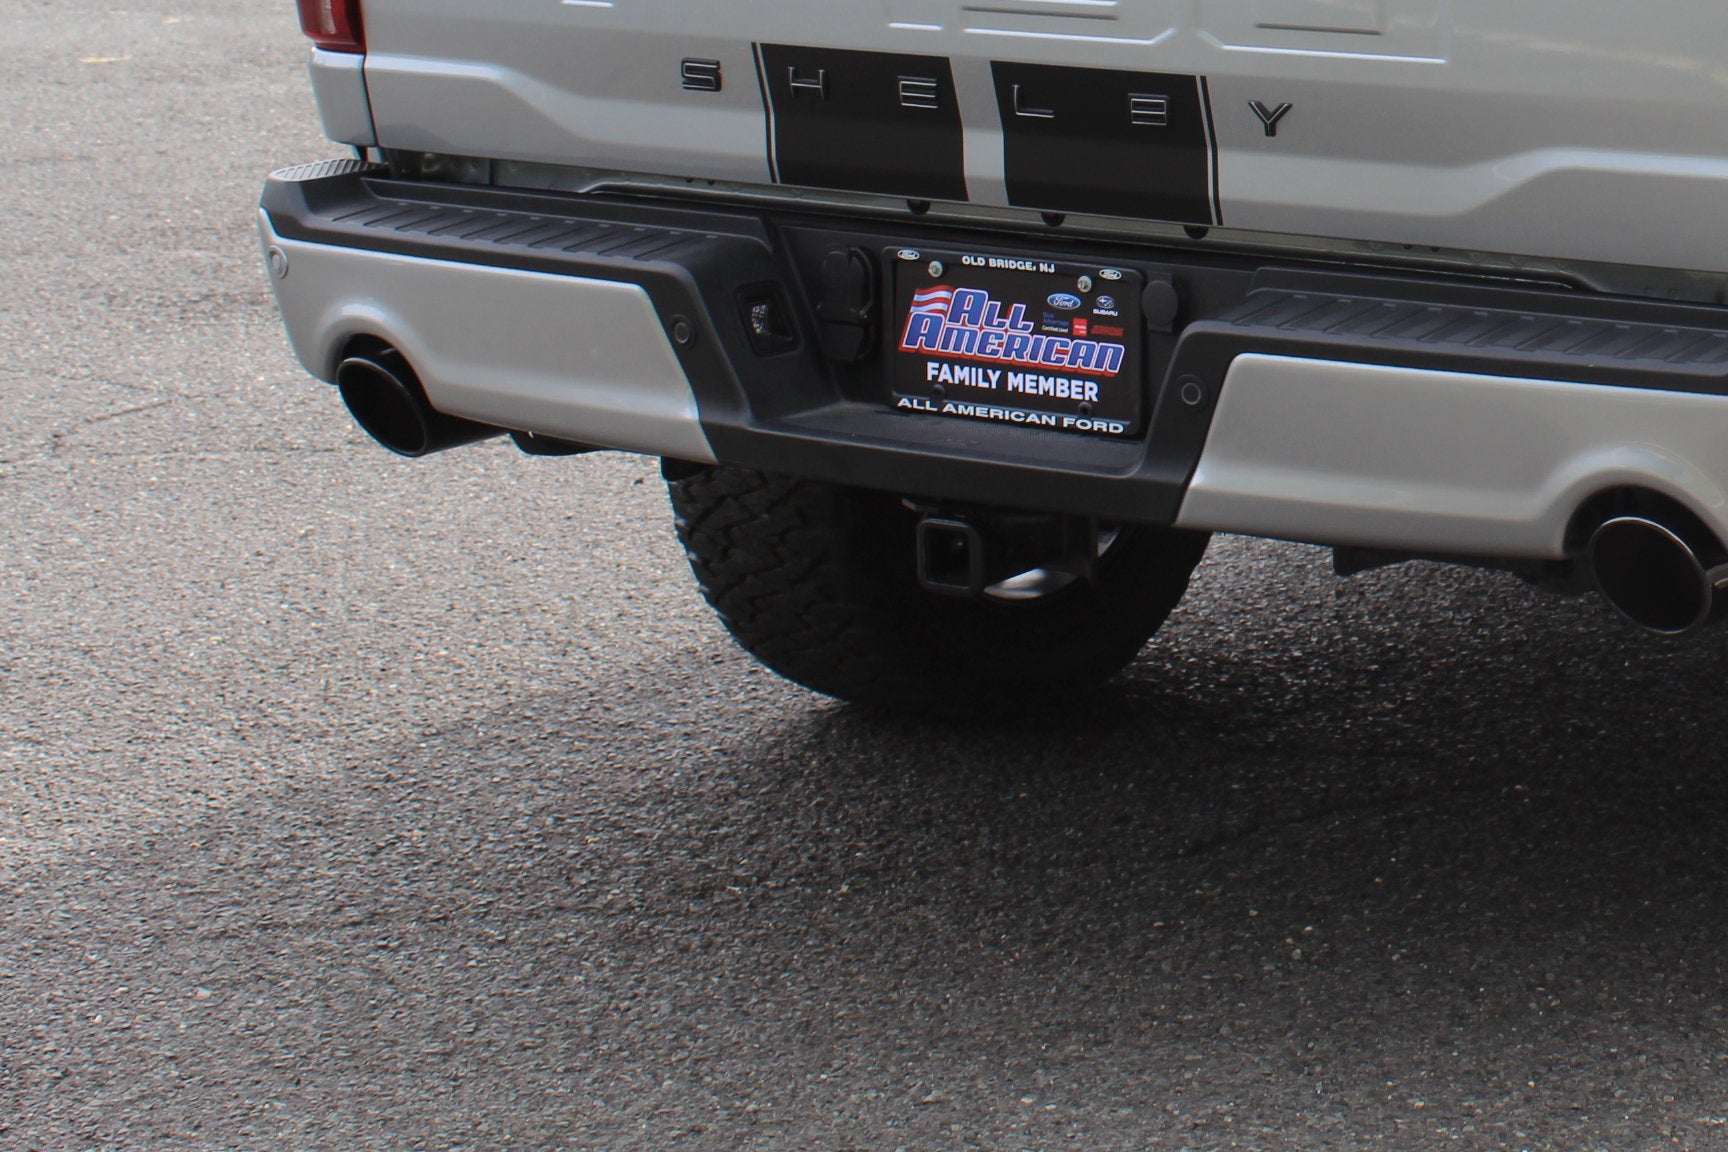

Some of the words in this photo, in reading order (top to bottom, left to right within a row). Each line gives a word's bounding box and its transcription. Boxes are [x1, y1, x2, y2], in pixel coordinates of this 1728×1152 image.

[681, 56, 1293, 138] SHELBY
[962, 255, 985, 267] OLD
[988, 257, 1036, 271] BRIDGE,
[1039, 262, 1055, 273] NJ
[1050, 295, 1078, 308] Ford
[1092, 308, 1119, 317] SUBARU
[926, 361, 1001, 389] FAMILY
[1007, 372, 1099, 402] MEMBER
[897, 397, 938, 412] ALL
[942, 401, 1057, 426] AMERICAN
[1062, 417, 1125, 434] FORD
